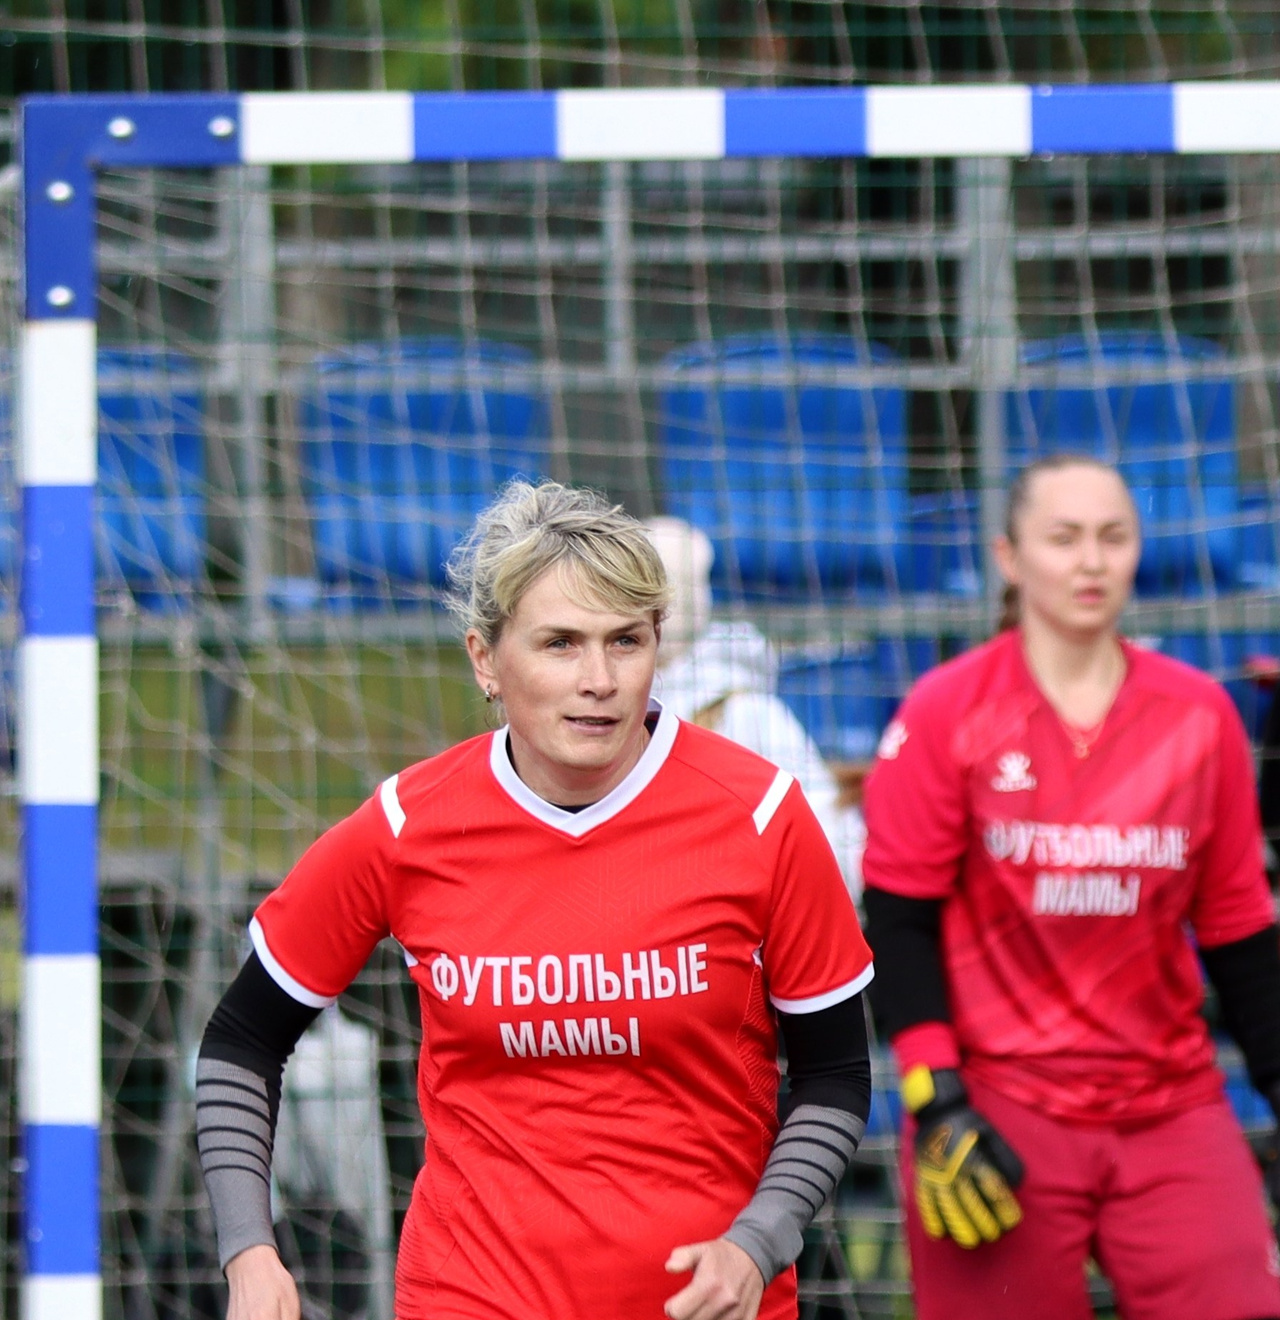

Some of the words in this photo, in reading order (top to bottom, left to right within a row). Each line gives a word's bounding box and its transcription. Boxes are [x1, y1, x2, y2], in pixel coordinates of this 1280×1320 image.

[983, 820, 1189, 871] ФУТБОЛЬНЫЕ
[1033, 872, 1141, 916] МАМЫ
[431, 943, 709, 1006] ФУТБОЛЬНЫЕ
[499, 1017, 641, 1058] МАМЫ
